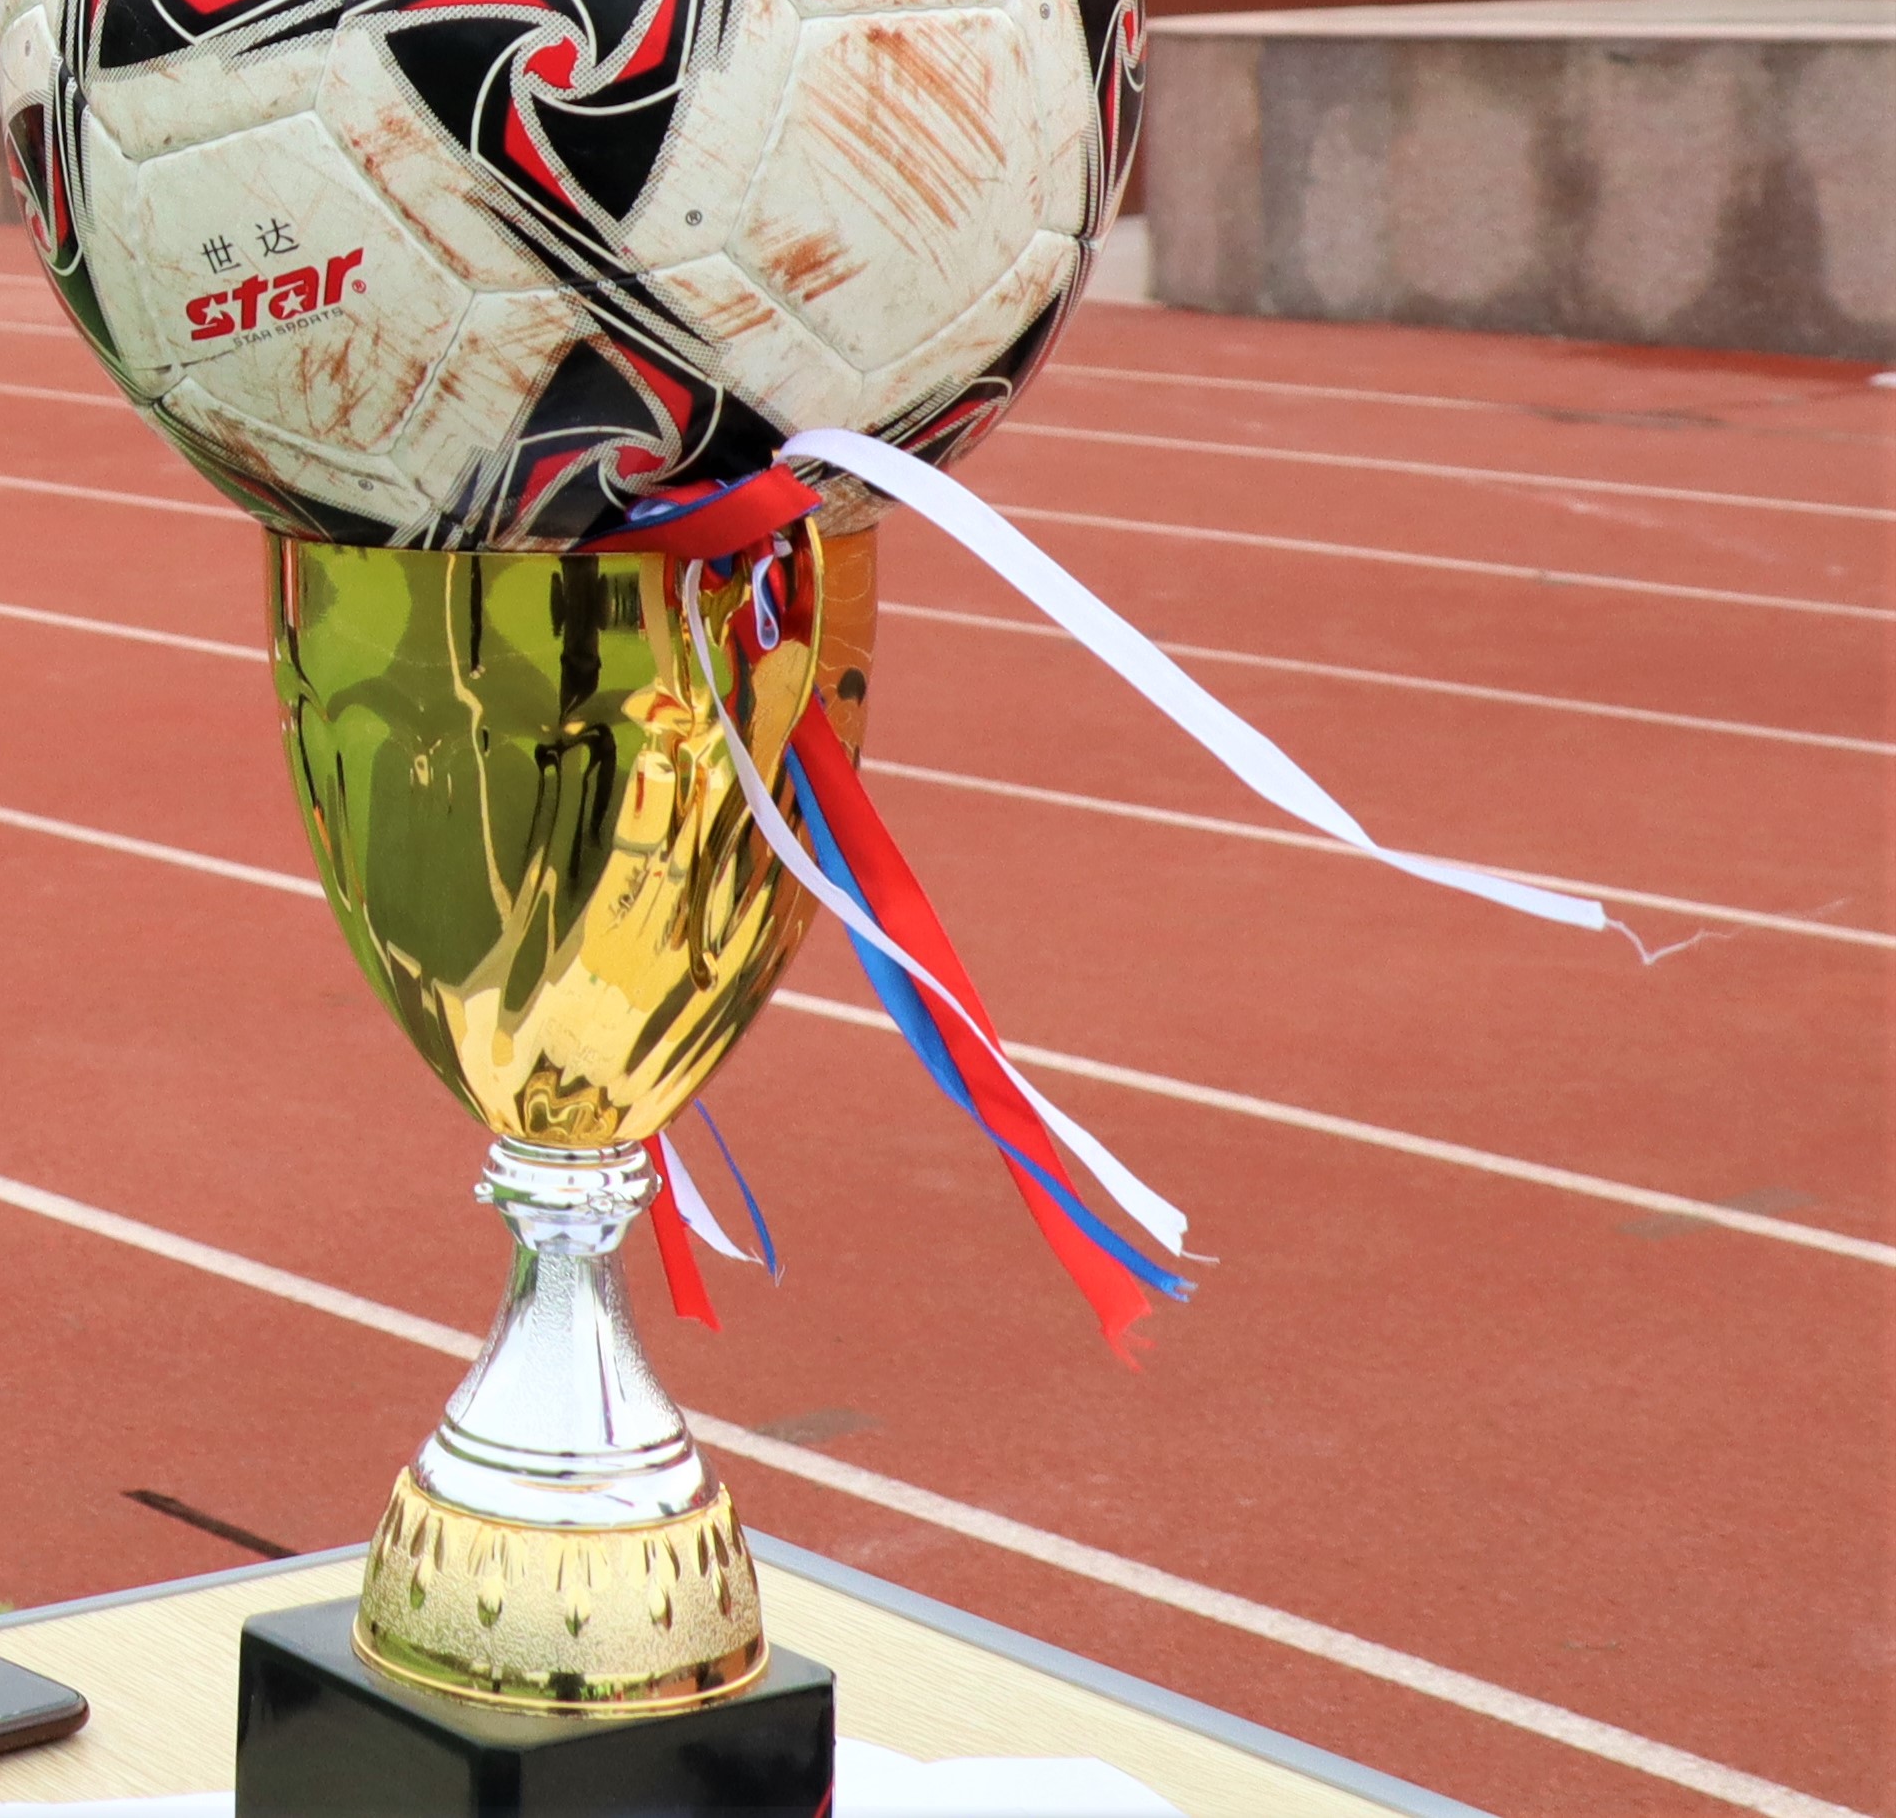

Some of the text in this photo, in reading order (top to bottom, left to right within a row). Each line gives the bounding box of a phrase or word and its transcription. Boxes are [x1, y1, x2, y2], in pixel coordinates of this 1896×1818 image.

[200, 217, 300, 274] 世达
[233, 306, 344, 348] STAR SPORTS
